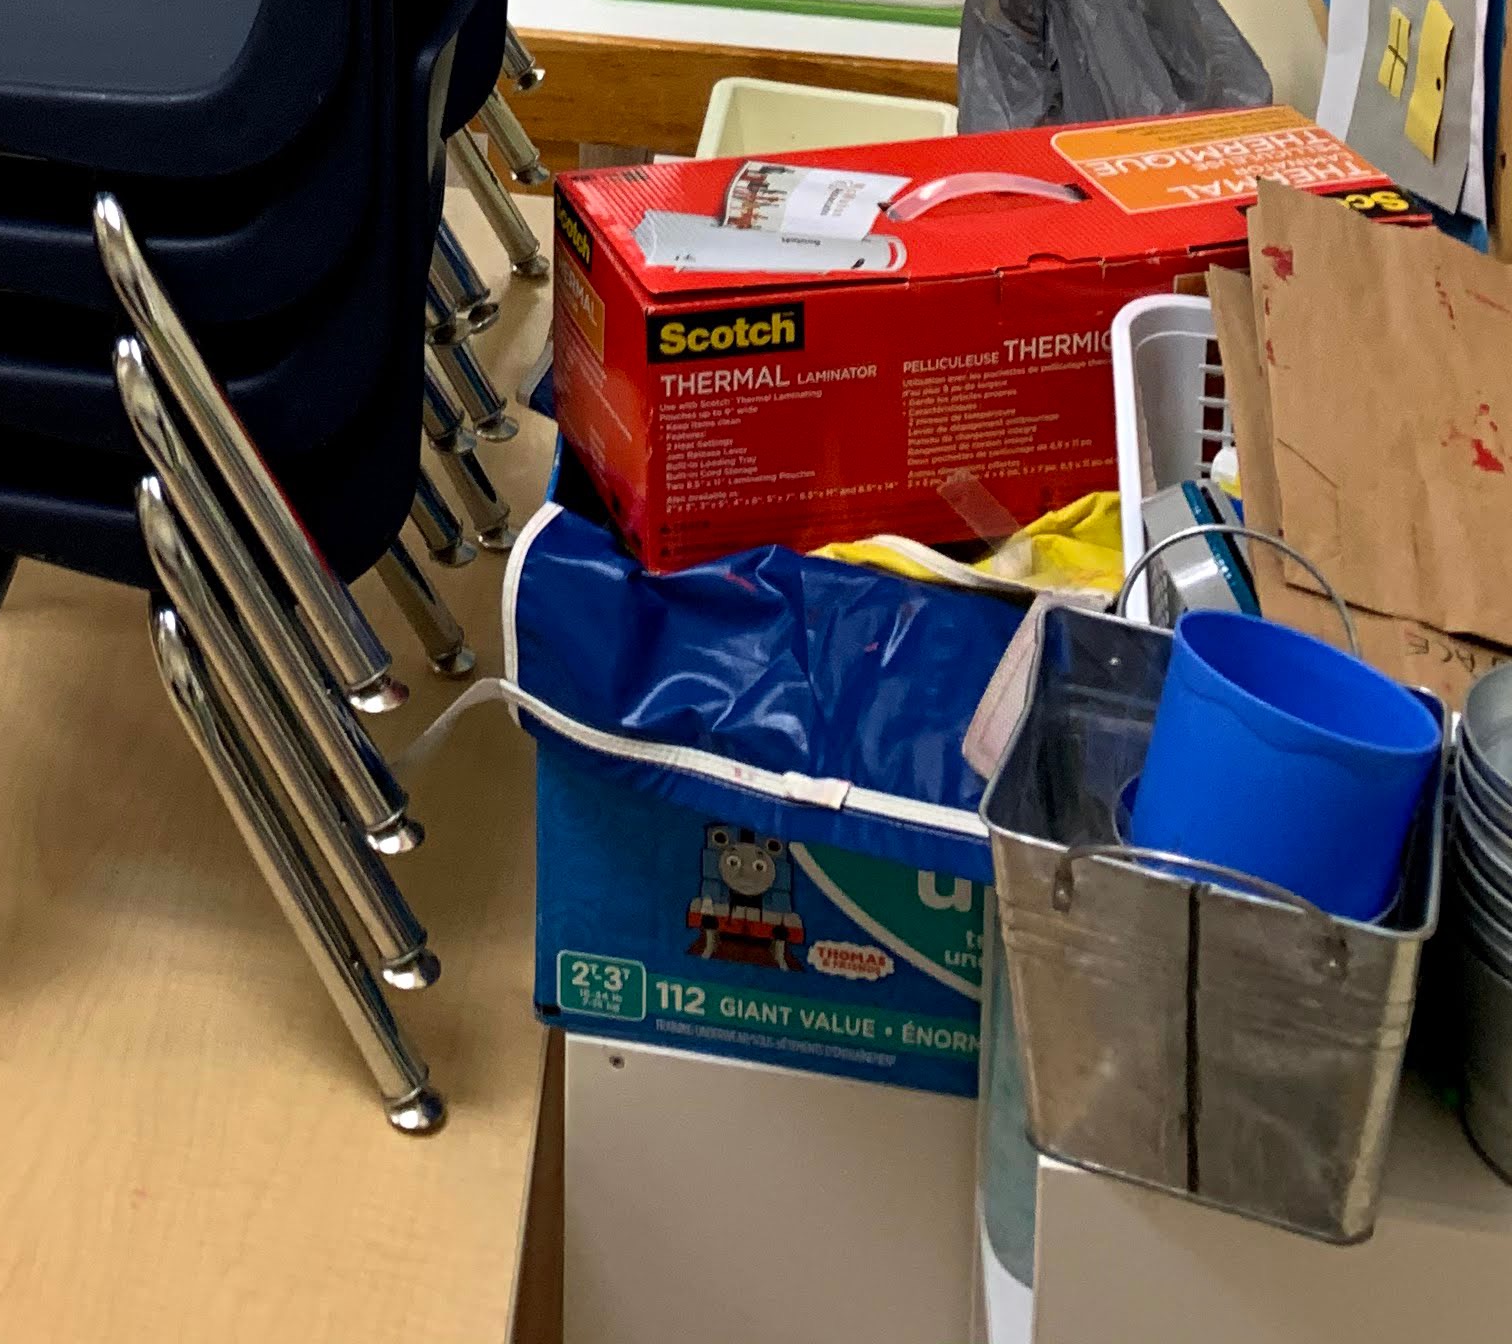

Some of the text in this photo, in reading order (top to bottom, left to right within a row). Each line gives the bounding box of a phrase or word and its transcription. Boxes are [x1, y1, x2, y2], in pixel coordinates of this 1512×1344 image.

[1093, 129, 1332, 178] THERMIQUE
[557, 196, 591, 265] Scotch
[659, 312, 795, 356] Scotch
[661, 365, 878, 397] THERMAL LAMINATOR
[903, 352, 1000, 373] PELLICULEUSE
[817, 946, 886, 967] THOMAS
[656, 980, 706, 1016] 112
[720, 996, 792, 1027] GIANT
[799, 1008, 875, 1038] VALUE
